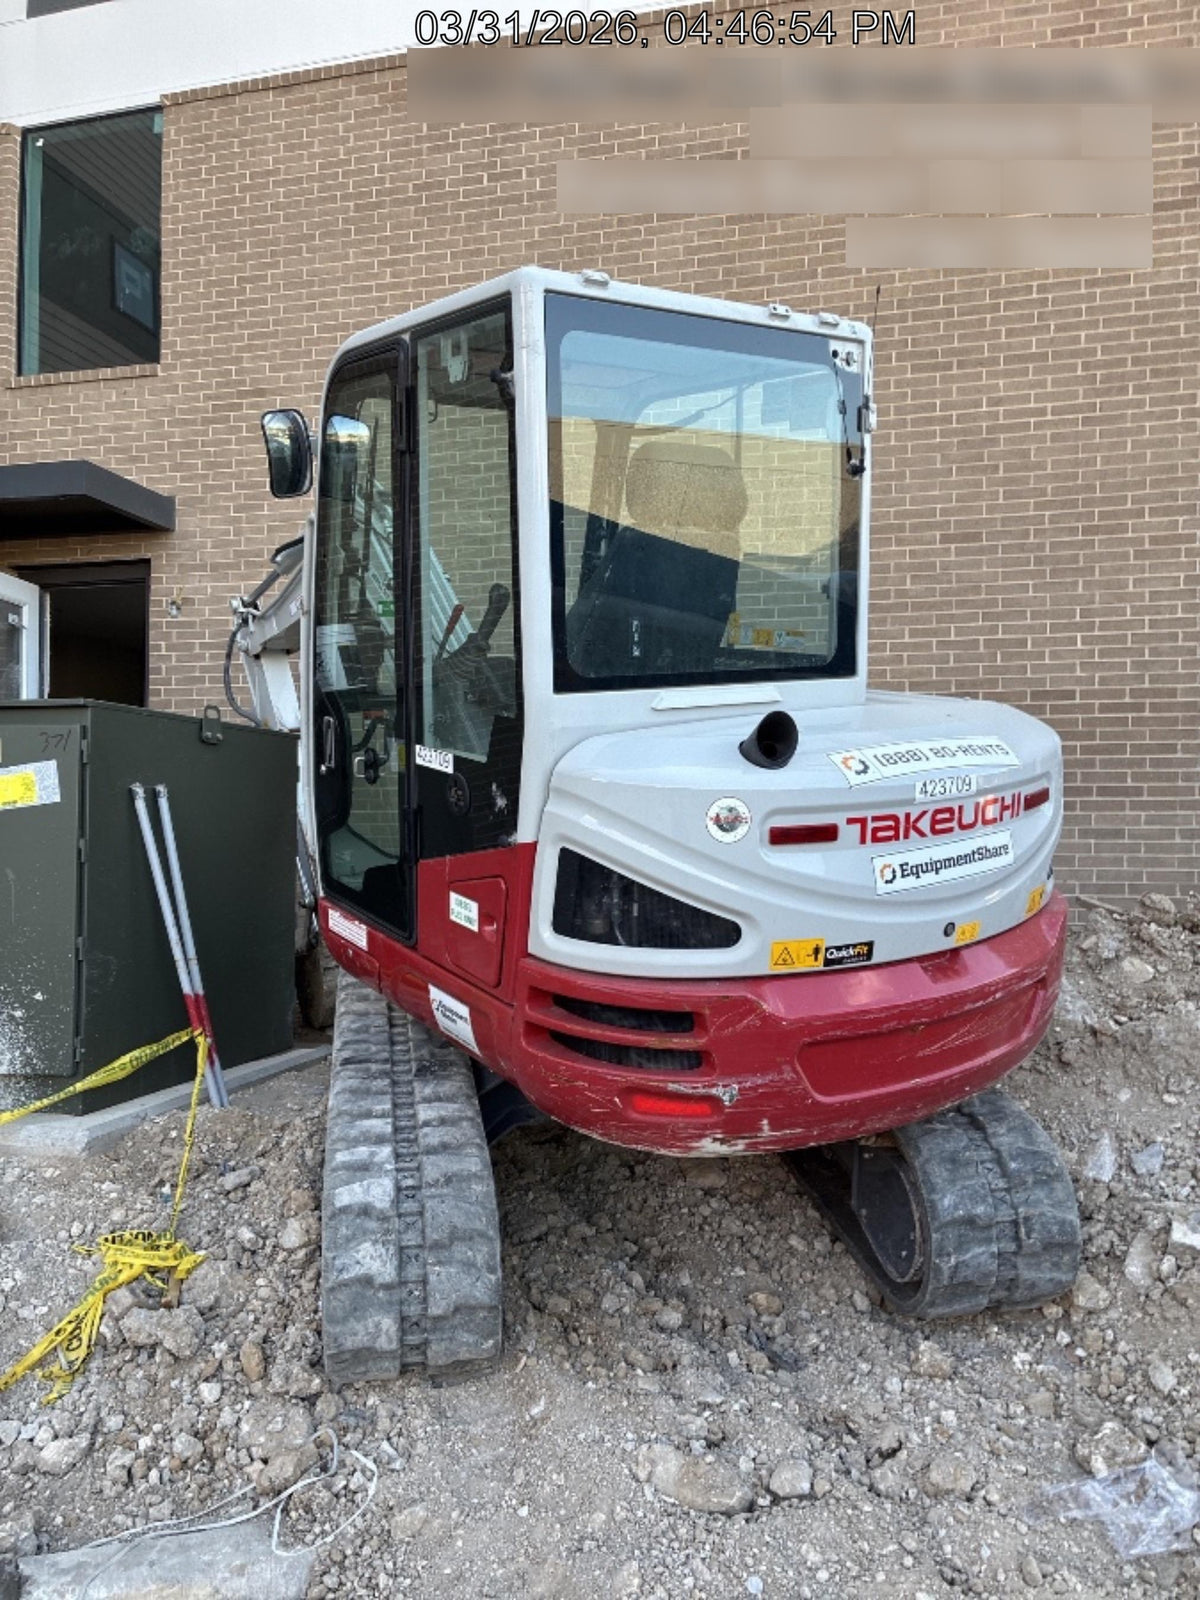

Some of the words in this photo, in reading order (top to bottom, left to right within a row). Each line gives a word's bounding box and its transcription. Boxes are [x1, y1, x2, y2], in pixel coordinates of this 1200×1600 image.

[873, 747, 929, 767] (888)
[919, 775, 972, 798] 423709
[899, 842, 1010, 880] EquipmentShare
